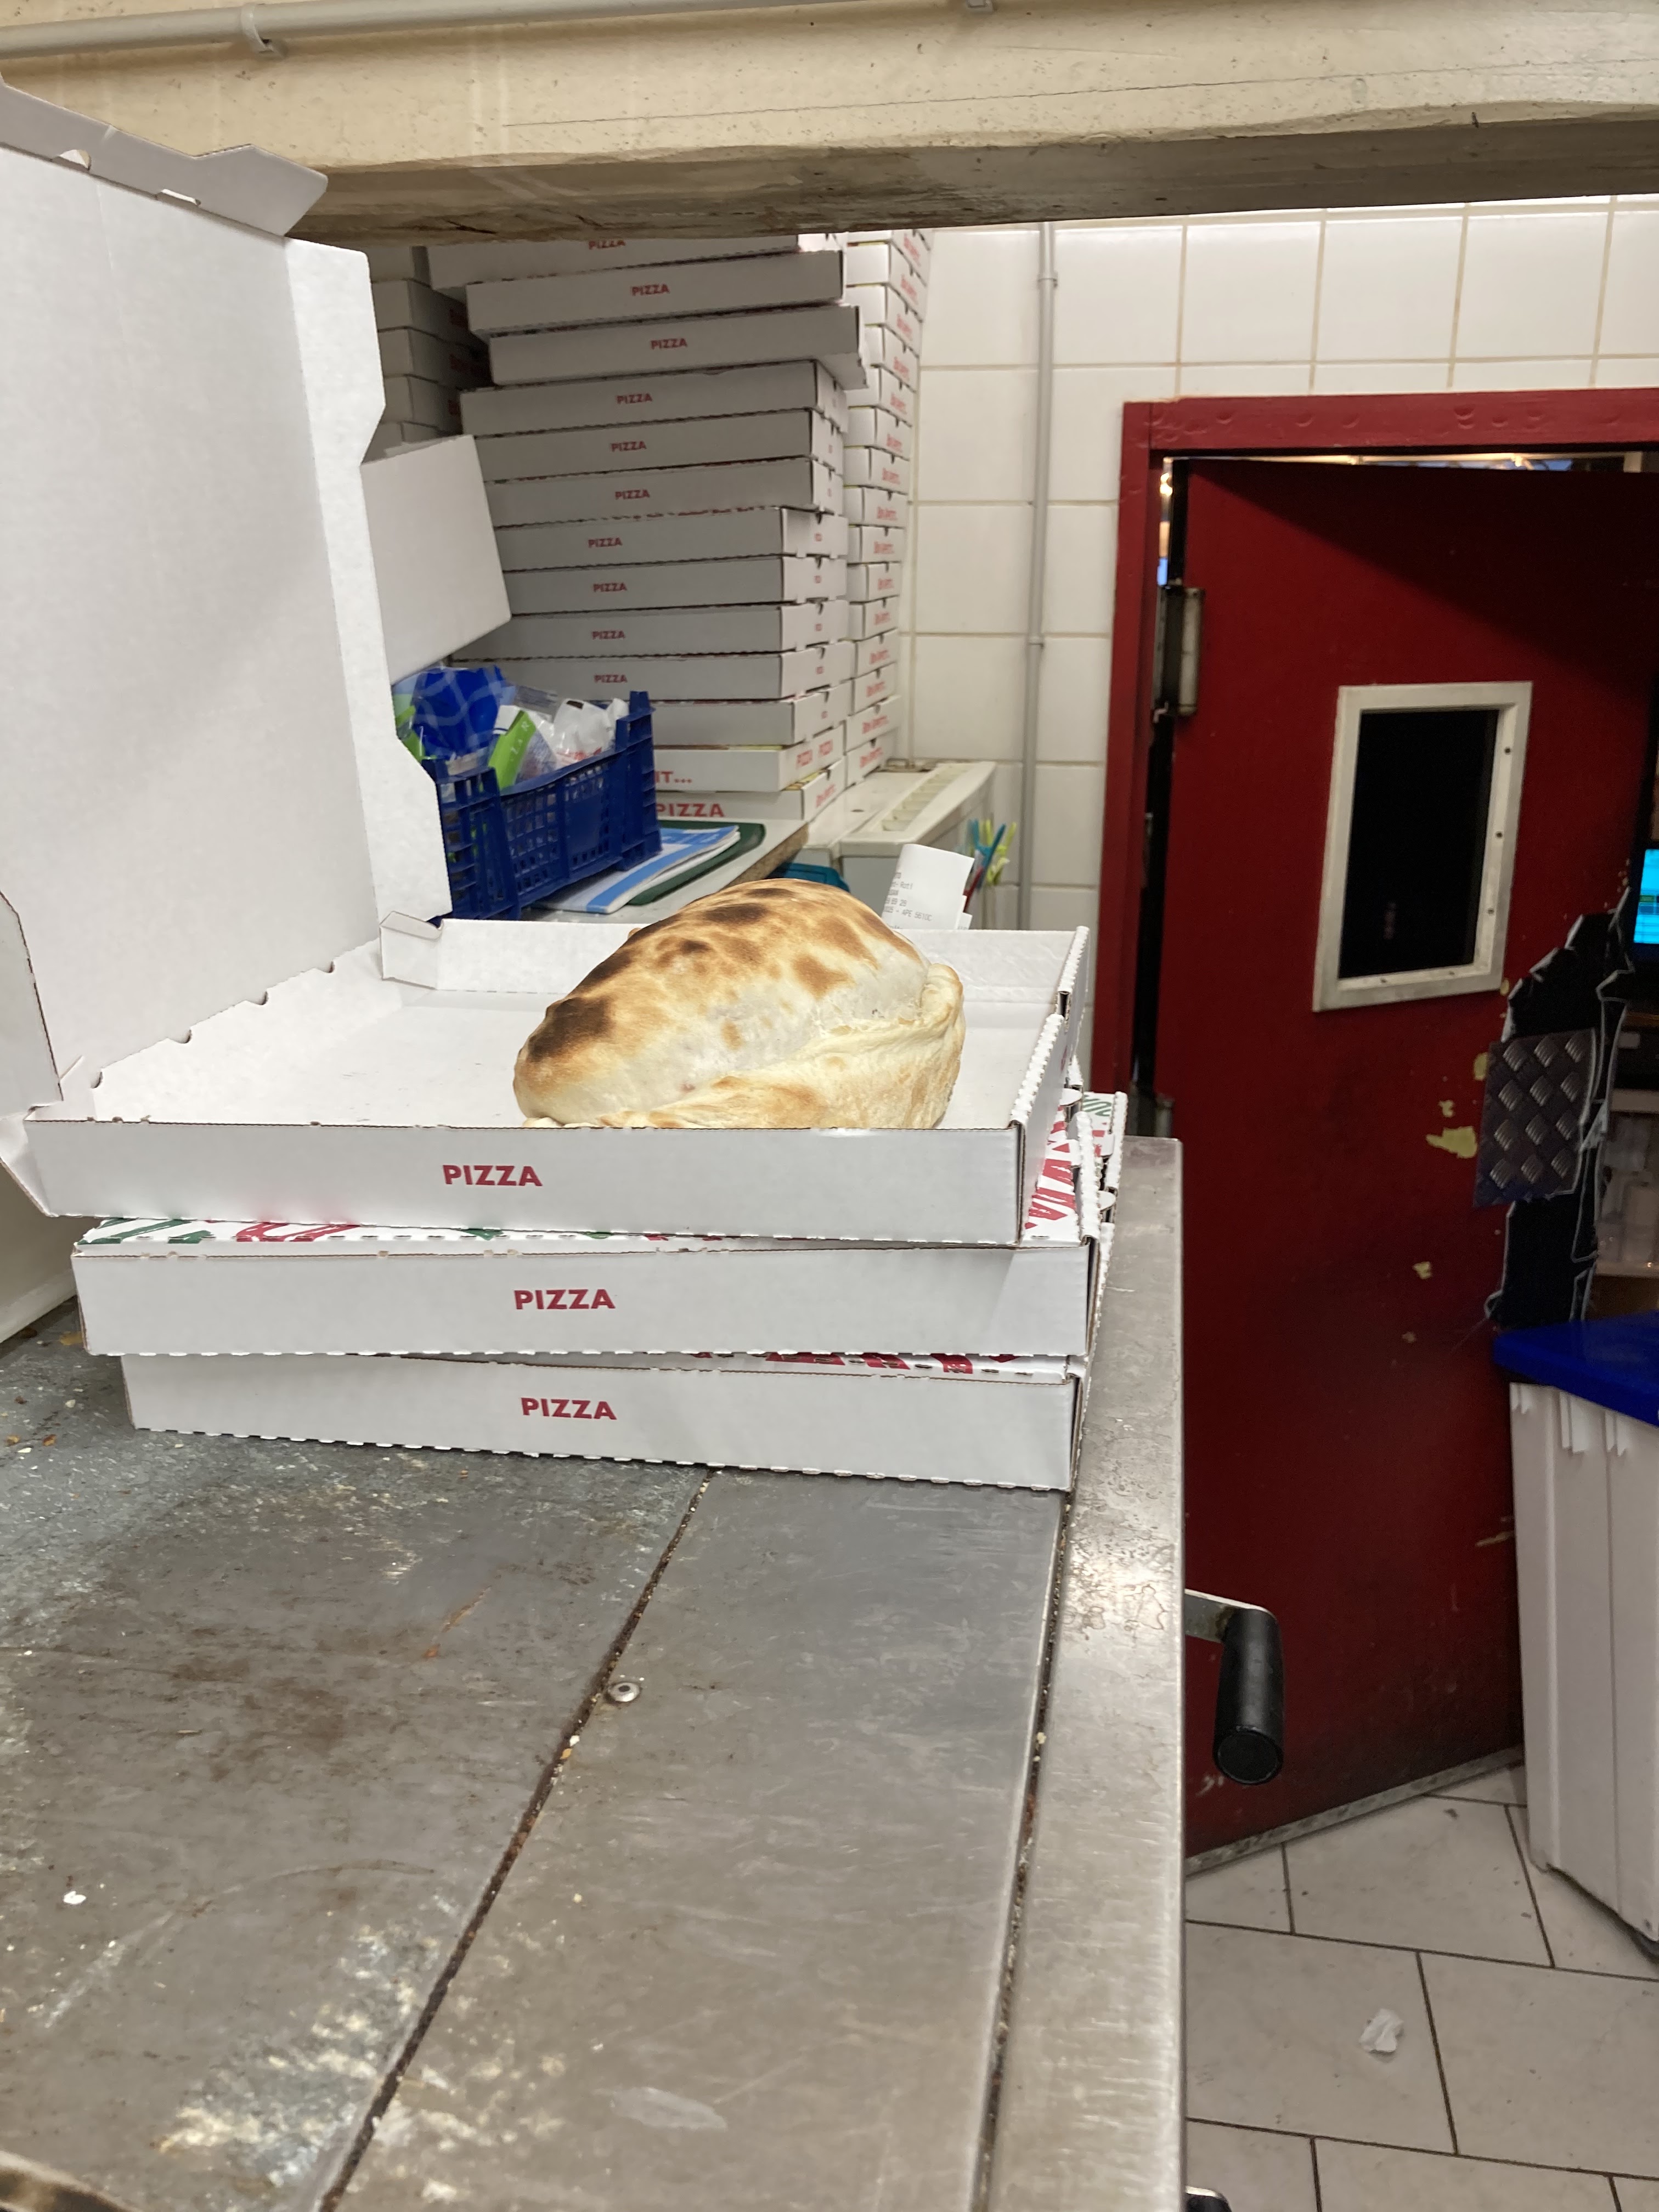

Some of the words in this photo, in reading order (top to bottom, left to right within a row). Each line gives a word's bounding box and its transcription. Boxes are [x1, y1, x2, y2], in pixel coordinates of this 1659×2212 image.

[631, 284, 670, 296] PIZZA
[651, 338, 687, 349] PIZZA
[616, 393, 653, 404] PIZZA
[611, 441, 647, 452] PIZZA
[614, 489, 650, 500] PIZZA
[588, 538, 622, 548] PIZZA
[593, 582, 627, 592] PIZZA
[592, 630, 625, 639] PIZZA
[594, 674, 628, 684] PIZZA
[657, 803, 724, 817] PIZZA
[443, 1165, 543, 1187] PIZZA
[515, 1289, 616, 1310] PIZZA
[521, 1397, 617, 1420] PIZZA
